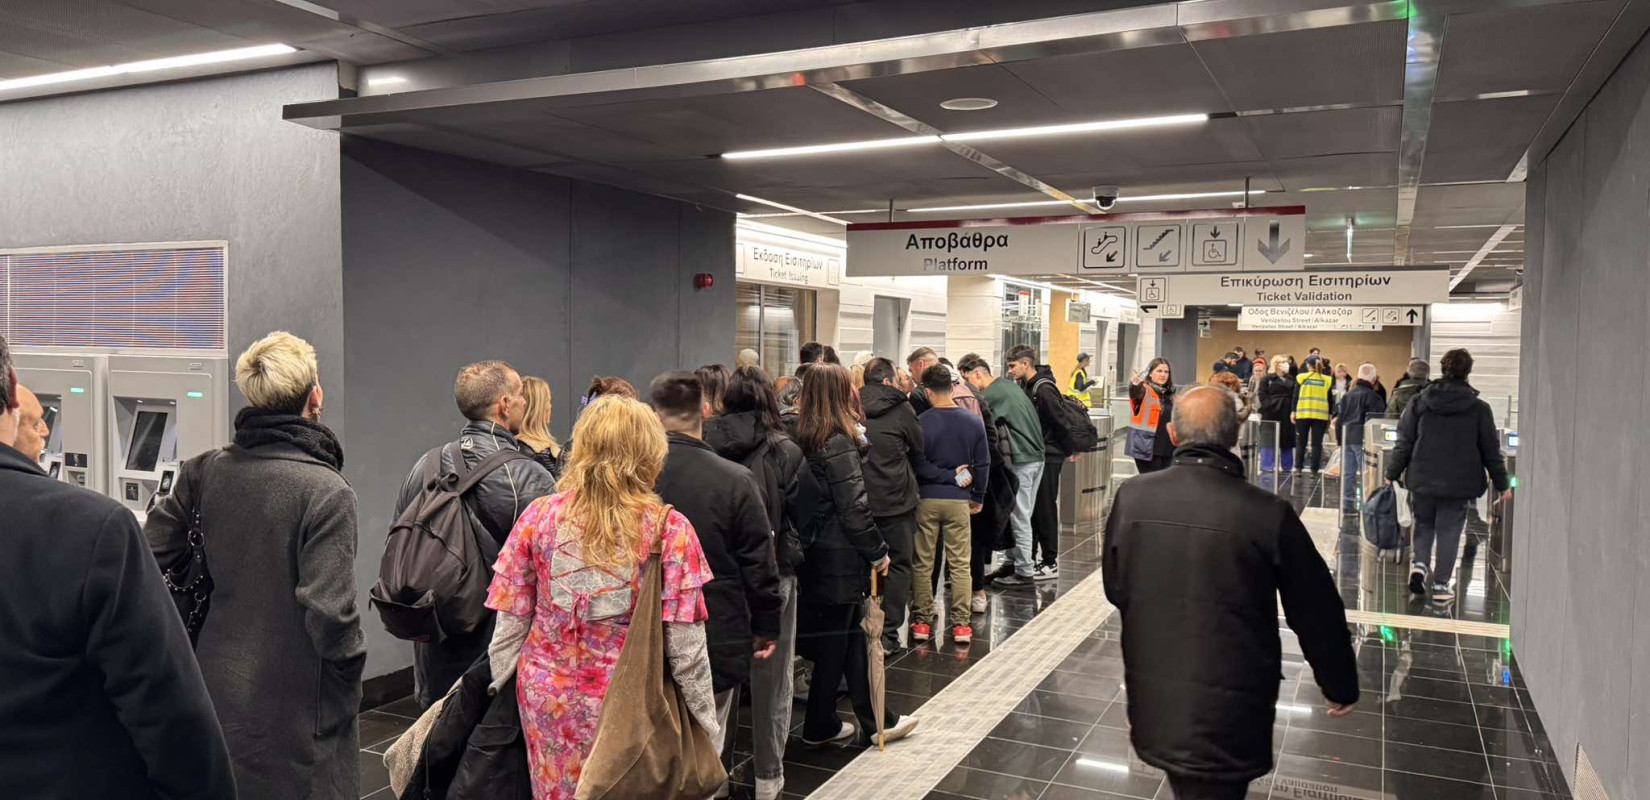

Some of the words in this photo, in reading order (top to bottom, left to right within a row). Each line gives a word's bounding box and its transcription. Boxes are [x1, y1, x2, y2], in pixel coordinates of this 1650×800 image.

[905, 232, 1009, 253] Αποβάθρα
[923, 258, 988, 271] Platform
[769, 267, 787, 280] Ticket
[1220, 275, 1304, 289] Επικύρωση
[1309, 274, 1391, 289] Εισιτηρίων
[1257, 292, 1291, 301] Ticket
[1294, 292, 1352, 301] Validation
